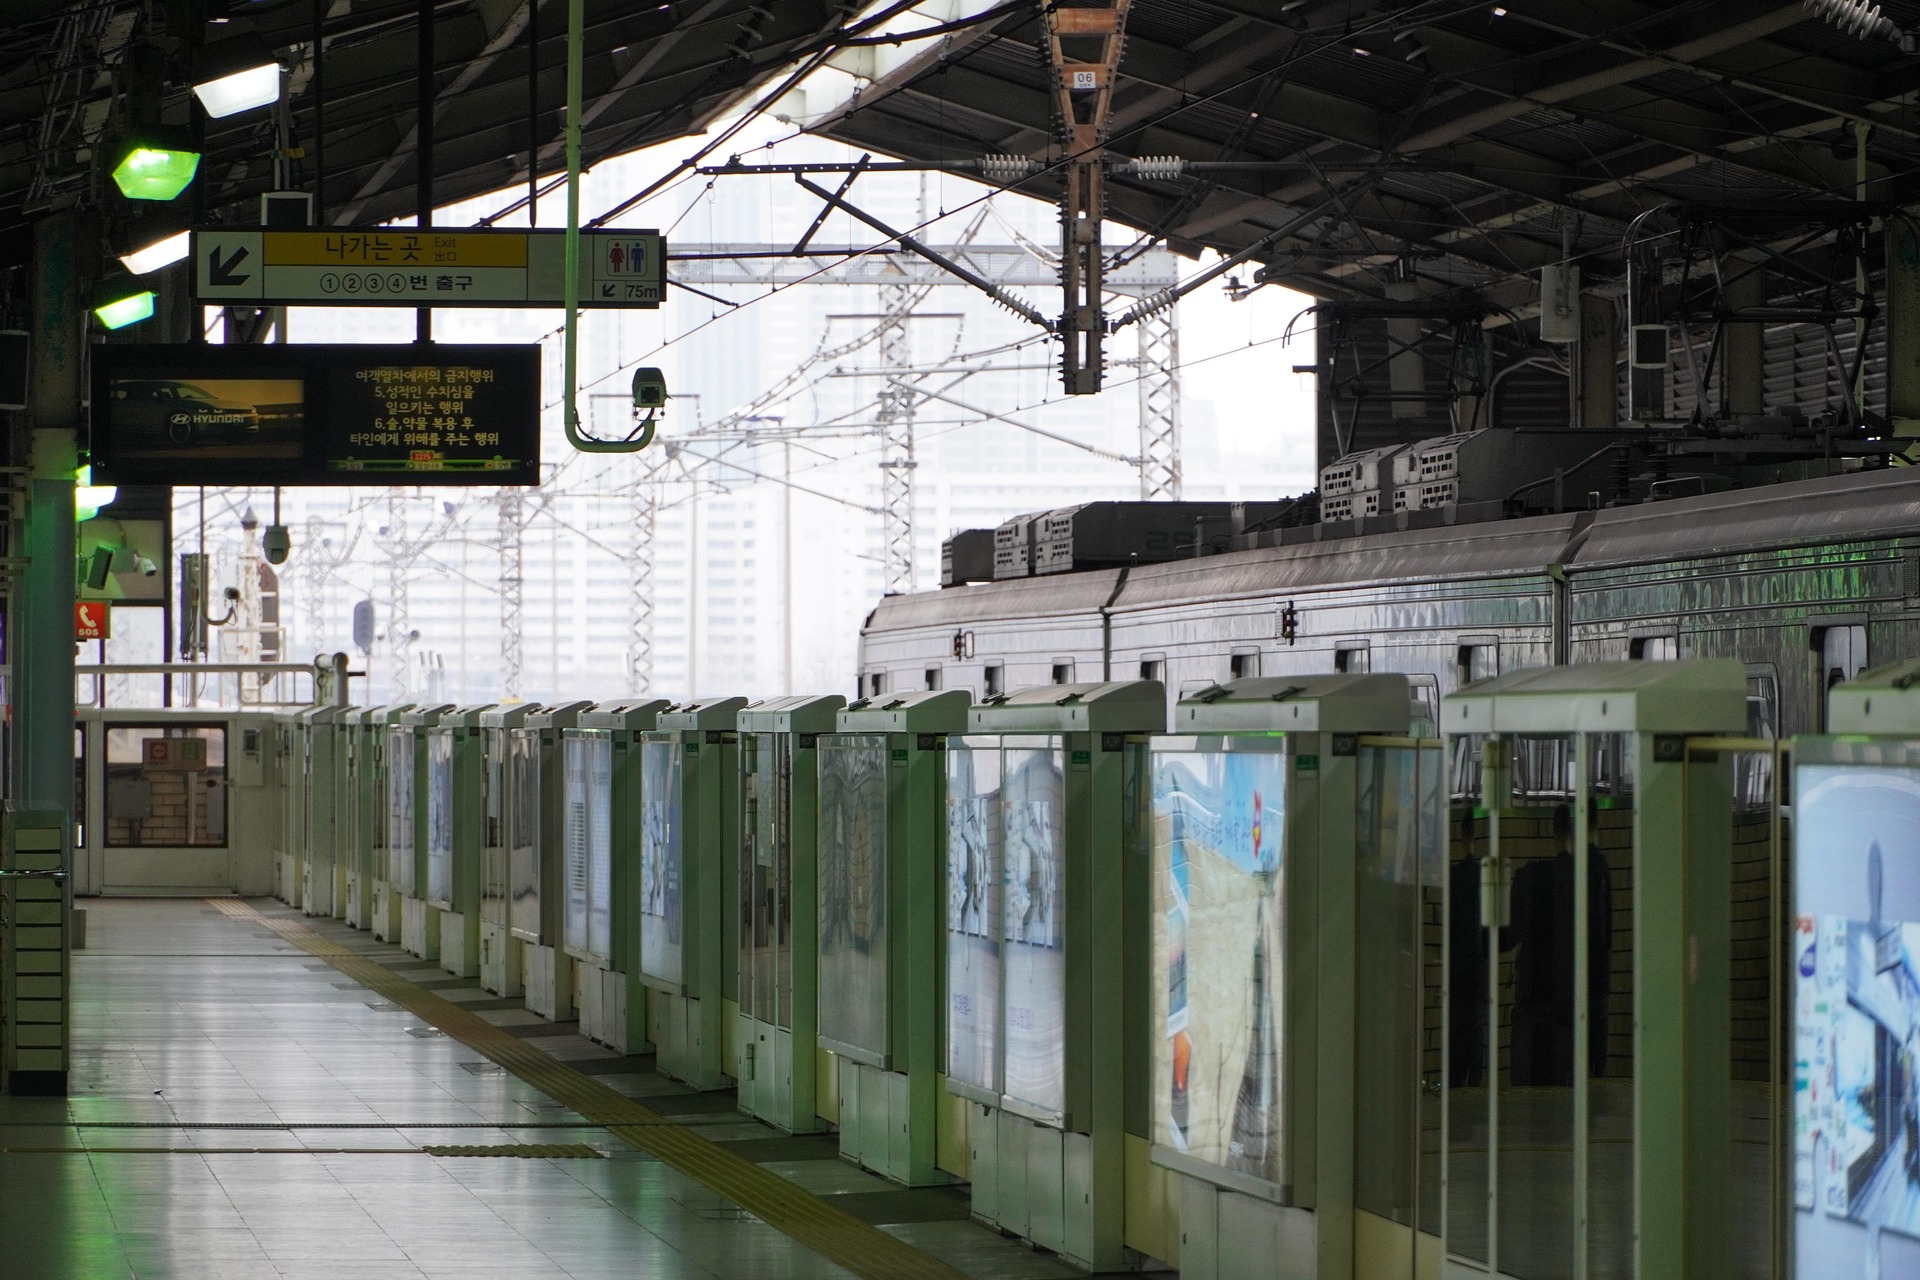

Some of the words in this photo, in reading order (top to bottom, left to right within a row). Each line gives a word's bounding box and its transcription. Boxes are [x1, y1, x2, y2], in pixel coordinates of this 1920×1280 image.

[1077, 73, 1093, 83] 06
[326, 234, 393, 261] 나가는
[400, 236, 422, 261] 곳
[434, 237, 457, 248] Exit
[435, 252, 457, 262] 出口
[436, 275, 473, 291] 출구
[627, 285, 657, 298] 75m
[355, 369, 441, 383] 여객열차에서의
[444, 369, 494, 383] 금지행위
[374, 385, 422, 399] 5.성적인
[426, 385, 475, 399] 수치심을
[385, 401, 435, 415] 일으키는
[439, 401, 464, 415] 행위
[193, 414, 245, 424] HYUNDAI
[374, 417, 428, 431] 6.술,약물
[431, 417, 458, 431] 복용
[461, 417, 475, 431] 후
[350, 432, 399, 446] 타인에게
[403, 432, 441, 446] 위해를
[444, 432, 470, 446] 주는
[474, 432, 499, 446] 행위
[78, 628, 99, 636] SOS
